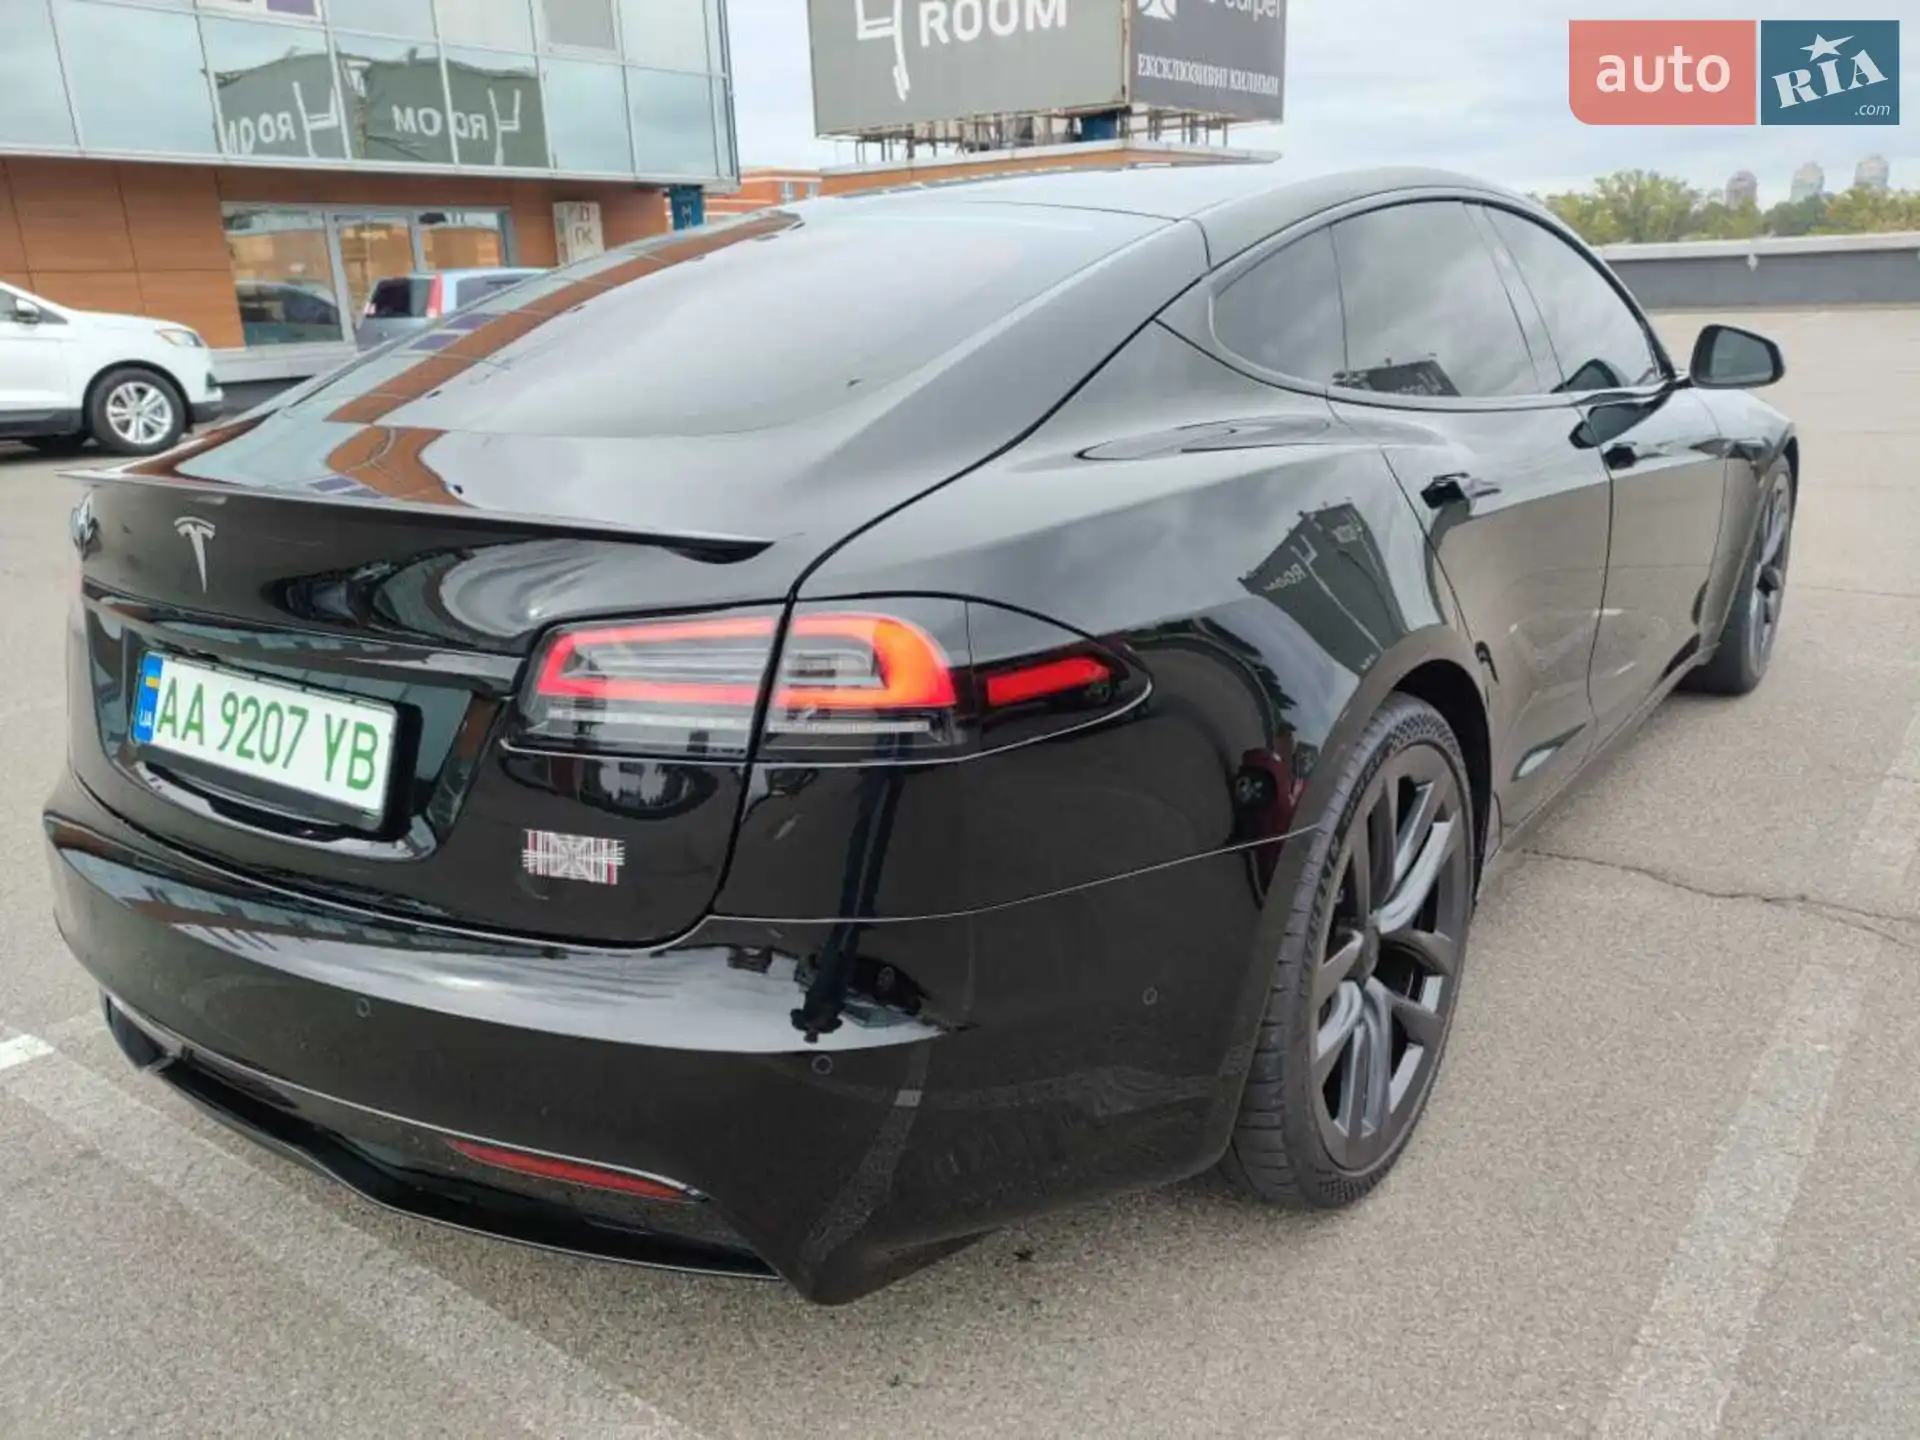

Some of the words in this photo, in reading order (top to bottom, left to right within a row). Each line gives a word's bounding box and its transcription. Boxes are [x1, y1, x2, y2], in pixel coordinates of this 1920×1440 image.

[919, 0, 1067, 47] ROOM
[156, 676, 205, 746] AA
[217, 691, 310, 770] 9207
[324, 713, 379, 791] YB
